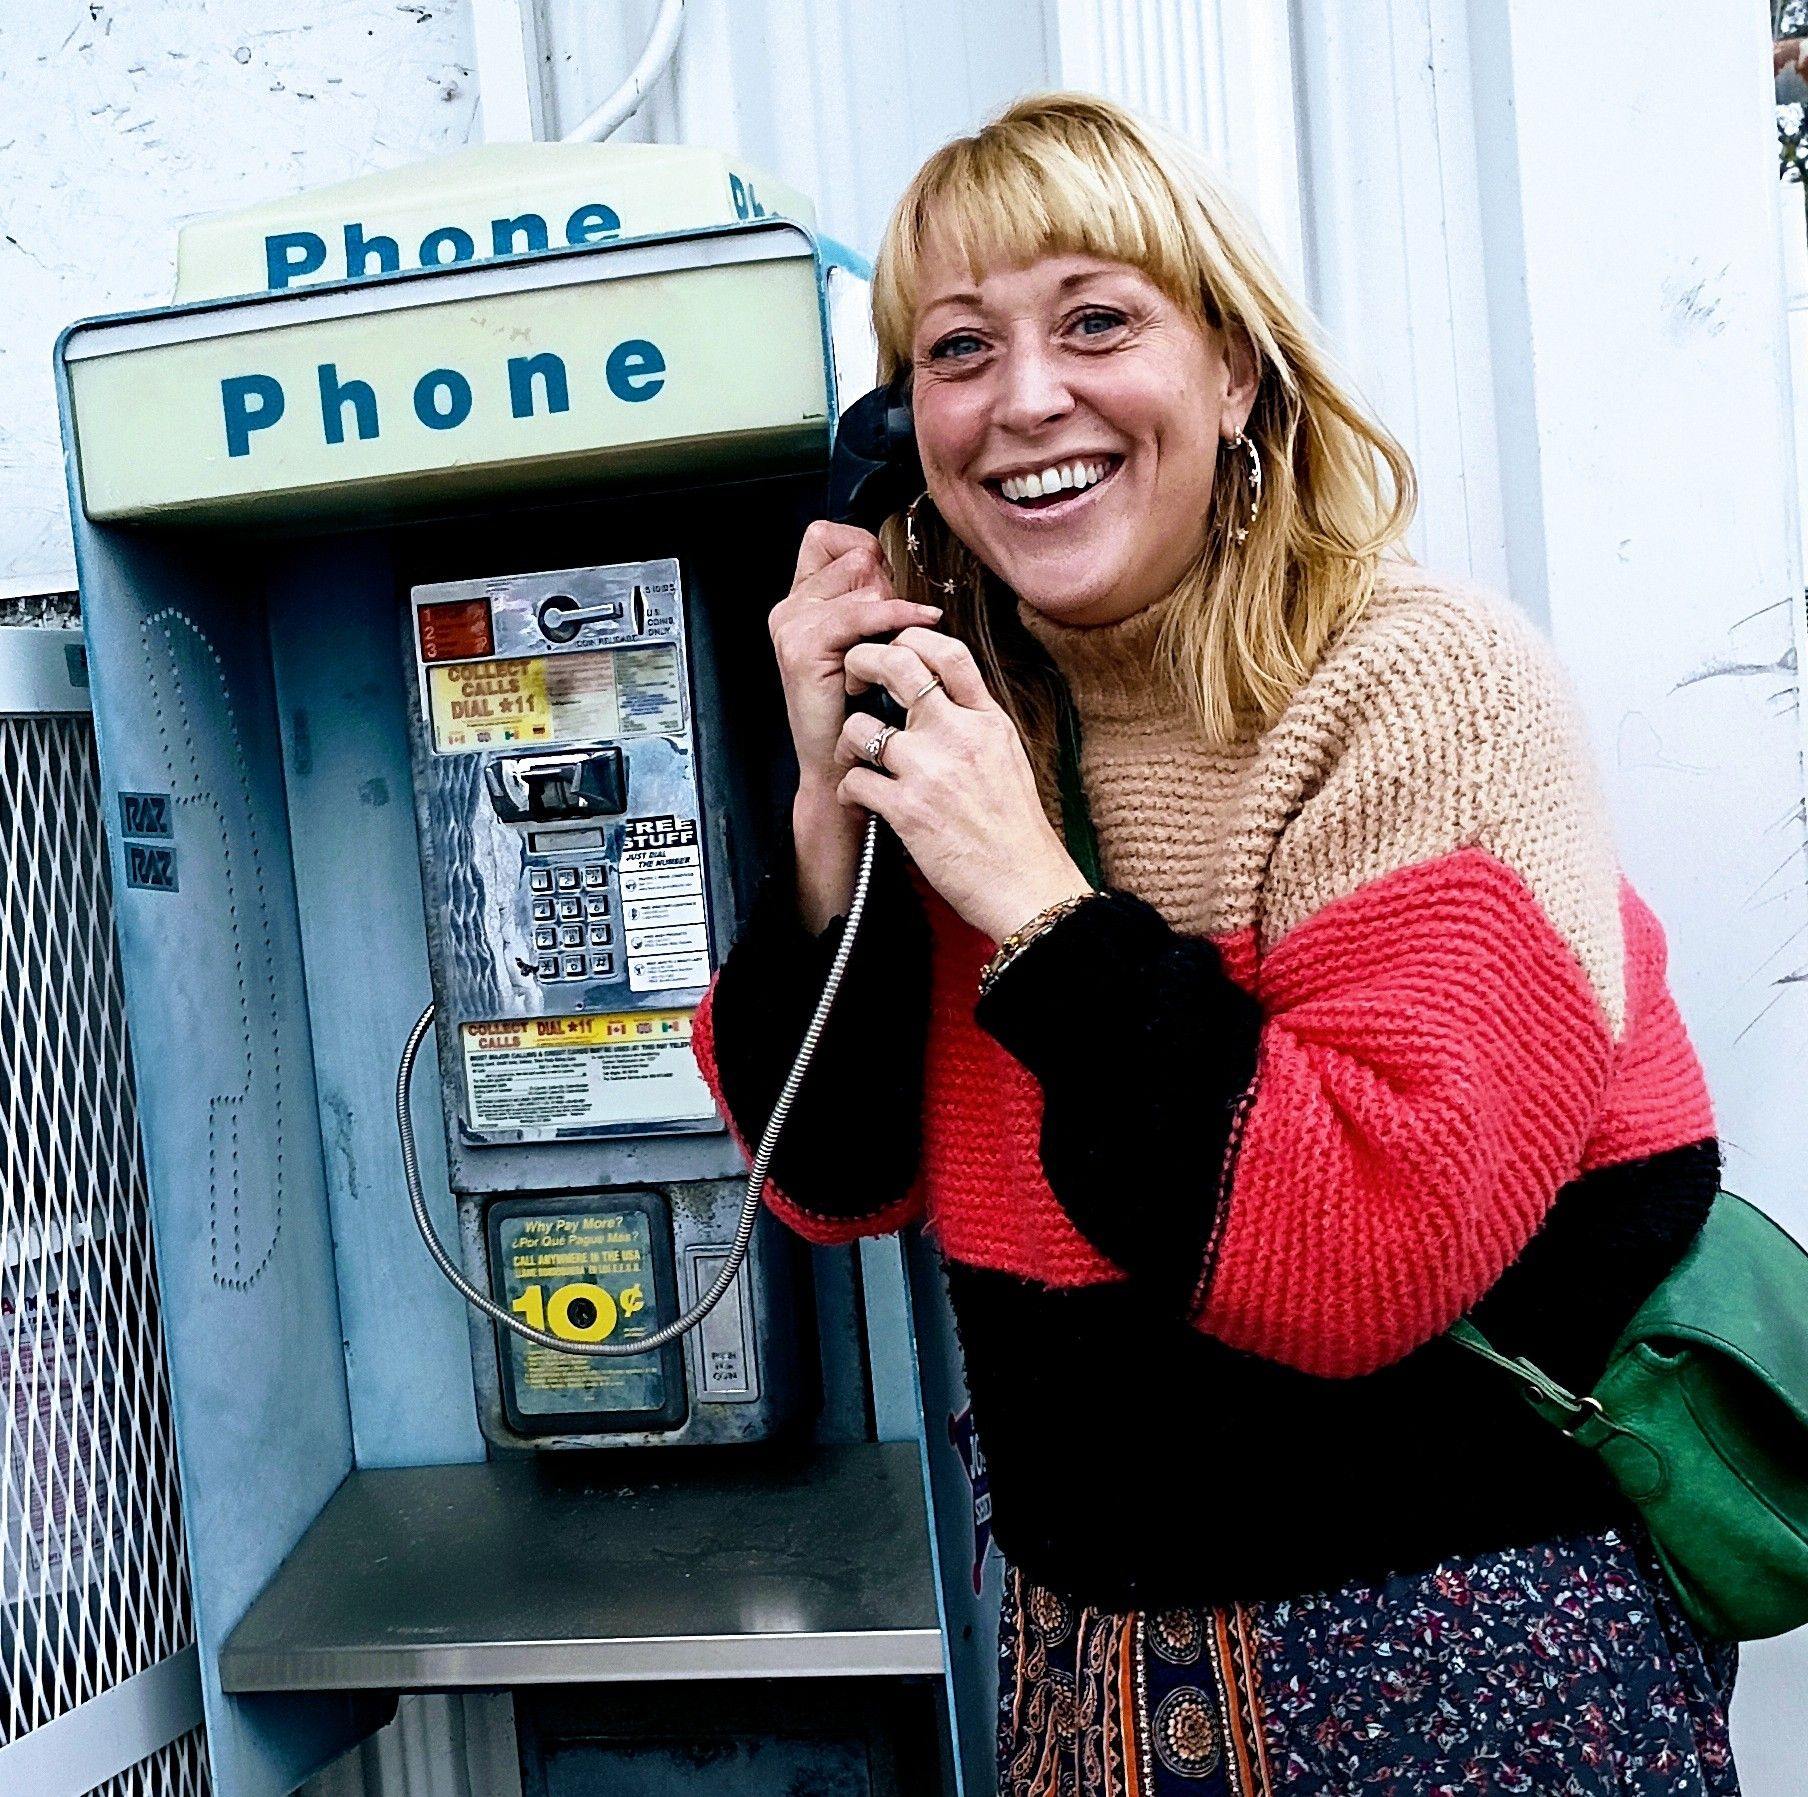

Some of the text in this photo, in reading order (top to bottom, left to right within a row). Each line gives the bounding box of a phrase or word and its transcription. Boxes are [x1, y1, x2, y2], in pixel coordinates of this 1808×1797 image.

[265, 203, 621, 290] Phone
[220, 338, 667, 458] Phone
[424, 626, 436, 640] 2
[426, 643, 438, 658] 3
[447, 660, 531, 683] COLLECT
[461, 678, 520, 698] CALLS
[450, 698, 495, 720] DIAL
[624, 818, 694, 835] FREE
[623, 830, 694, 850] STUFF
[467, 1021, 529, 1037] COLLECT
[536, 1020, 566, 1036] DIAL
[478, 1035, 521, 1049] CALLS
[524, 1216, 624, 1235] Why Pay More?
[513, 1254, 537, 1267] CALL
